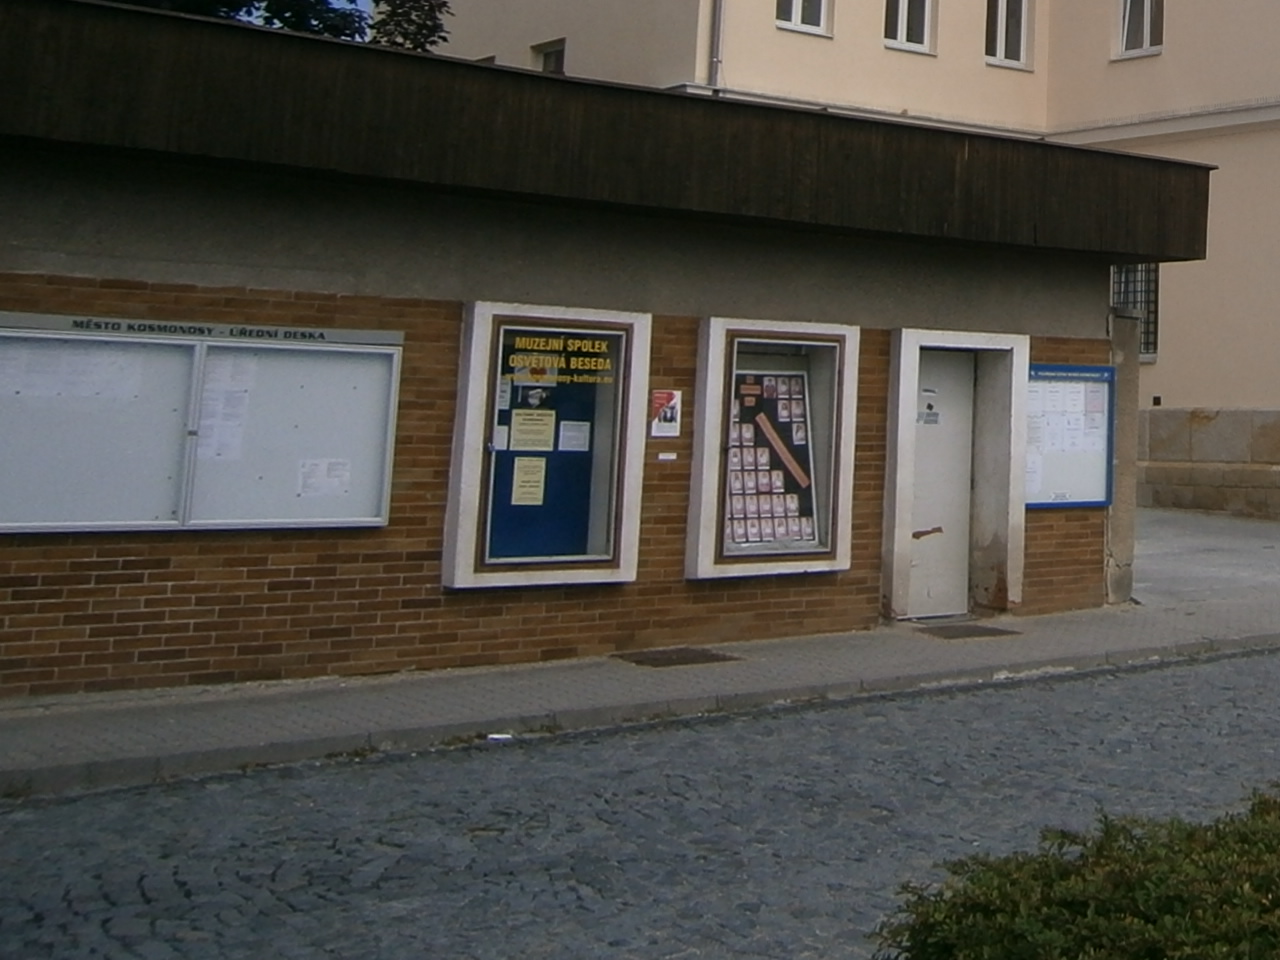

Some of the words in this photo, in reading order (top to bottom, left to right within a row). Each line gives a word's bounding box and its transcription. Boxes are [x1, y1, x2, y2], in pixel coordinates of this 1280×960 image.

[72, 319, 122, 331] MĚSTO
[127, 322, 215, 336] KOSMONOSY
[283, 330, 327, 340] DESKA
[514, 335, 565, 351] MUZEJNÍ
[567, 339, 609, 353] SPOLEK
[508, 352, 567, 368] OSVĚTOVÁ
[570, 356, 612, 370] BESEDA
